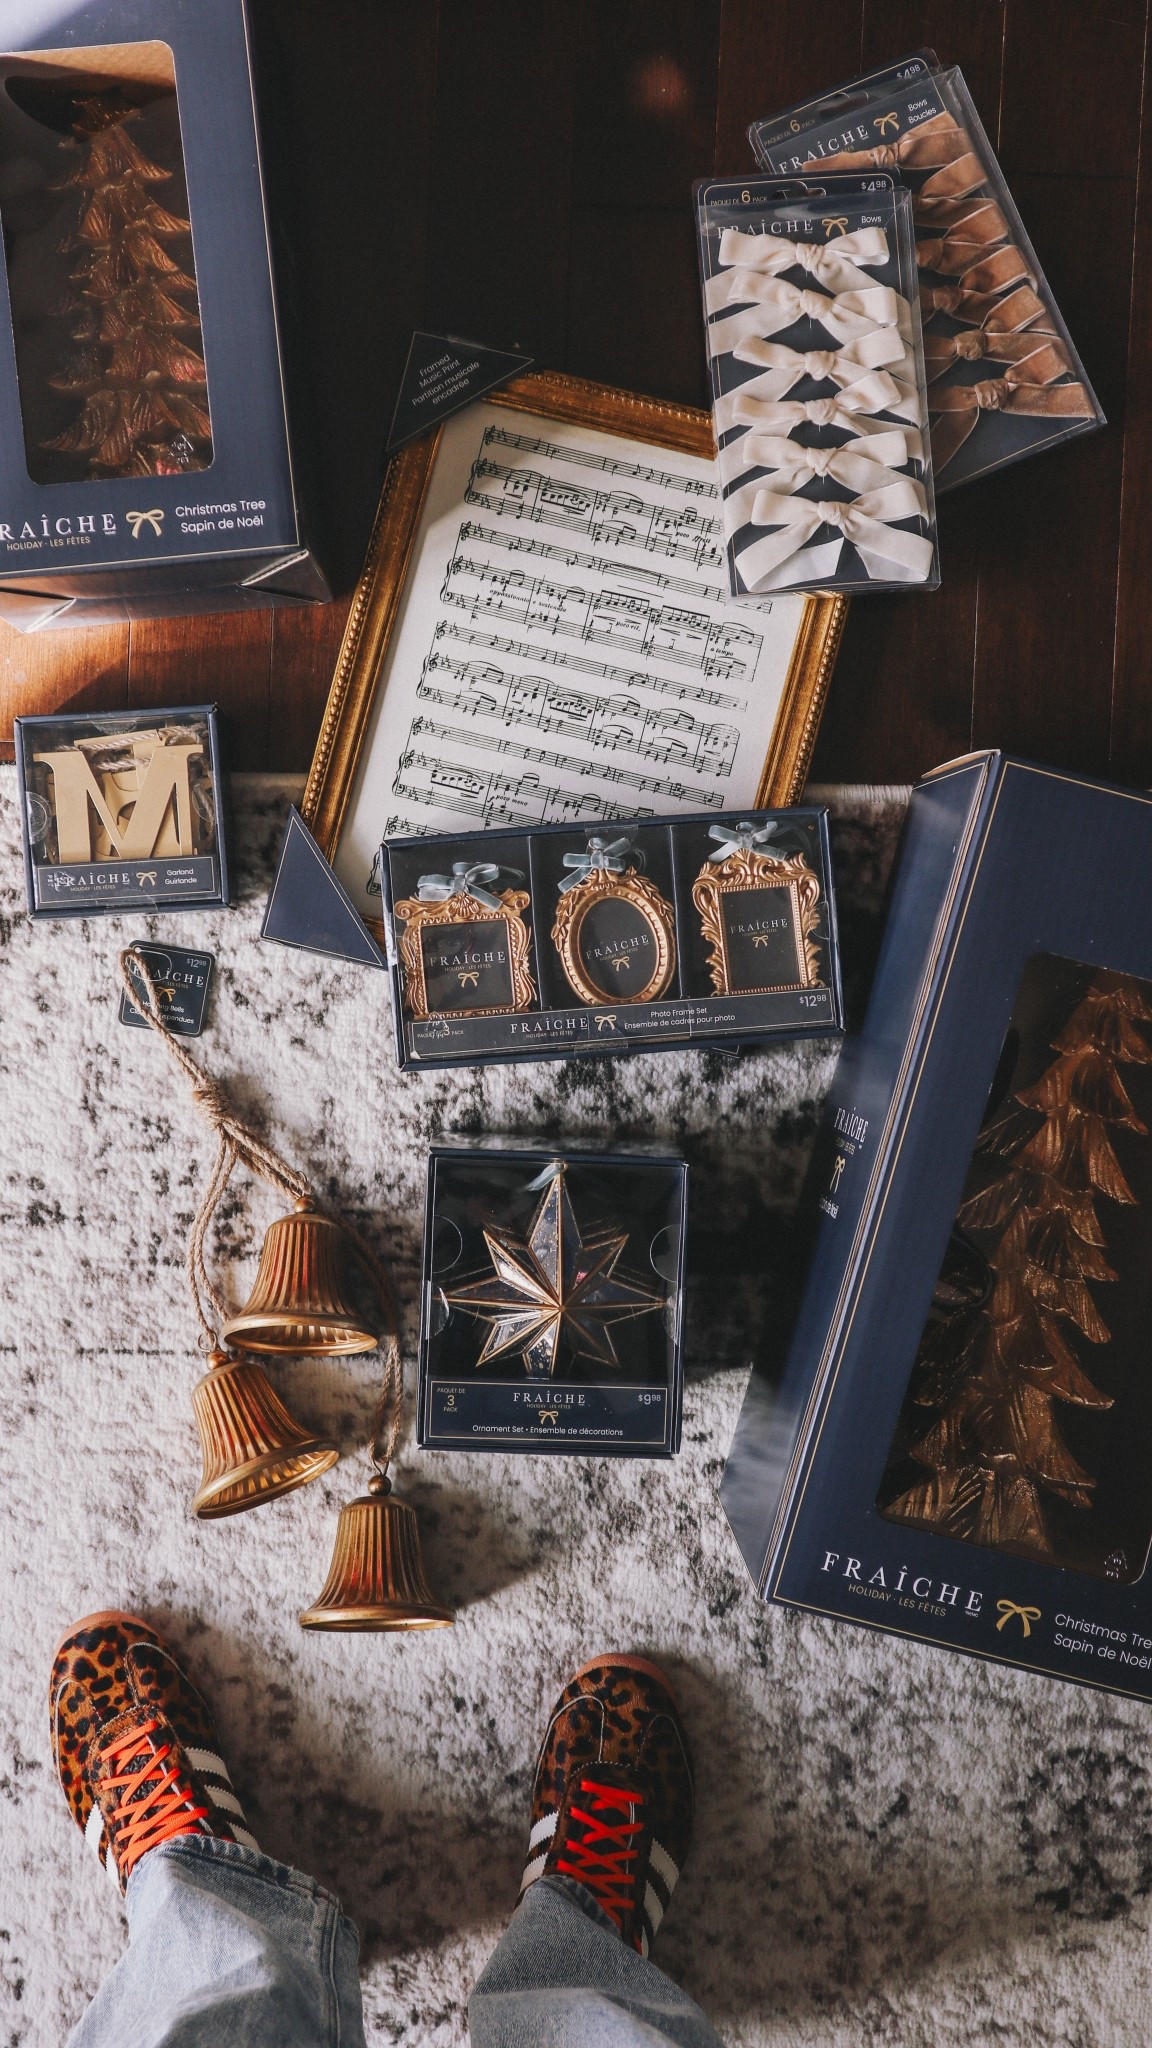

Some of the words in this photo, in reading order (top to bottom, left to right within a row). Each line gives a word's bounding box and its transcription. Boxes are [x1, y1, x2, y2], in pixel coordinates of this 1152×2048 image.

[908, 99, 928, 112] Bows
[908, 107, 937, 124] Boucles
[763, 134, 785, 147] PAQUET
[790, 120, 801, 132] 6
[801, 119, 816, 129] PACK
[741, 190, 751, 203] 6
[861, 215, 882, 224] Bows
[419, 354, 451, 377] Framed
[419, 370, 442, 388] Music
[442, 359, 461, 374] Print
[411, 382, 445, 406] Partition
[444, 361, 480, 386] musicale
[432, 378, 470, 405] encadrée
[175, 503, 238, 517] Christmas
[239, 500, 266, 511] Tree
[0, 513, 117, 540] RAÎCHE
[180, 520, 216, 534] Sapin
[218, 518, 234, 529] de
[237, 514, 264, 528] Noël
[6, 540, 43, 551] HOLIDAY
[50, 539, 64, 547] LES
[66, 535, 91, 545] FÊTES
[716, 648, 734, 656] tempo
[56, 873, 131, 887] FRAÎCHE
[166, 868, 194, 876] Garland
[164, 876, 197, 885] Guirlande
[730, 918, 788, 934] FRAÎCHE
[585, 935, 649, 960] FRAÎCHE
[429, 951, 506, 967] FRAÎCHE
[170, 1005, 185, 1013] Bells
[650, 1009, 671, 1018] Photo
[672, 1008, 695, 1016] Frame
[696, 1007, 708, 1015] Set
[510, 1017, 588, 1034] FRAÎCHE
[624, 1020, 659, 1030] Ensemble
[659, 1019, 669, 1027] de
[670, 1017, 696, 1026] cadres
[696, 1016, 713, 1025] pour
[714, 1014, 736, 1024] photo
[443, 1025, 450, 1036] 3
[447, 1394, 455, 1406] 3
[513, 1390, 586, 1404] FRAÎCHE
[472, 1425, 511, 1433] Ornament
[512, 1425, 524, 1433] Set
[530, 1426, 566, 1434] Ensemble
[567, 1427, 578, 1435] de
[579, 1427, 624, 1436] décorations
[820, 1551, 983, 1612] FRAÎCHE
[848, 1583, 892, 1602] HOLIDAY
[898, 1597, 916, 1609] LES
[918, 1602, 947, 1617] FÊTES
[1055, 1613, 1128, 1643] Christmas
[1132, 1633, 1152, 1649] Tre
[1053, 1633, 1094, 1654] Sapin
[1097, 1646, 1117, 1660] de
[1120, 1651, 1152, 1670] Noël
